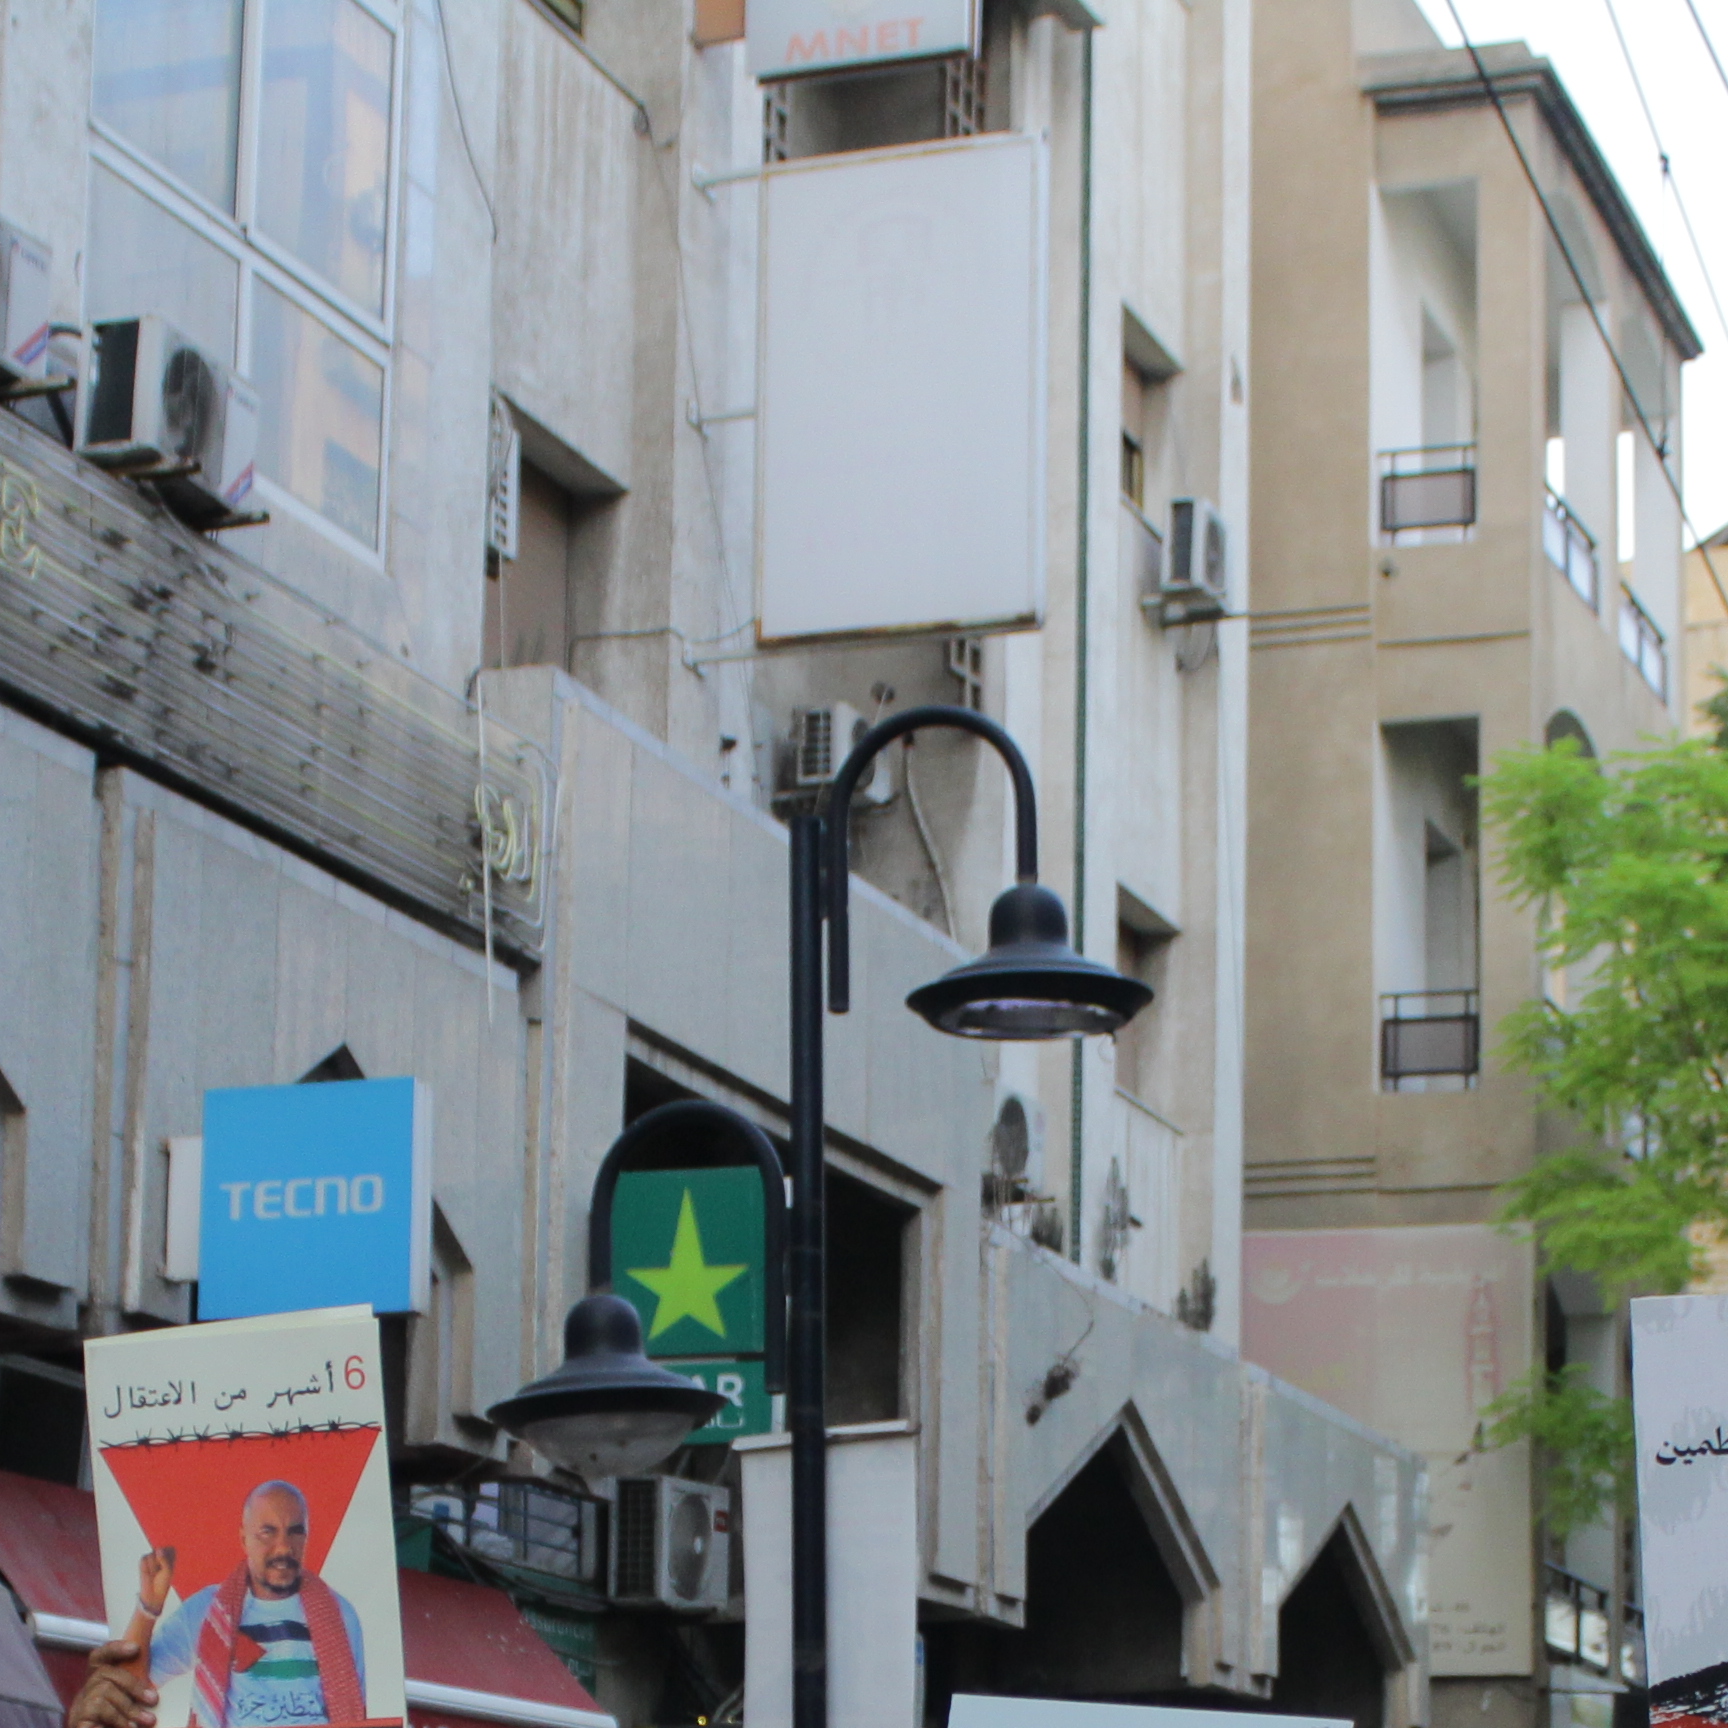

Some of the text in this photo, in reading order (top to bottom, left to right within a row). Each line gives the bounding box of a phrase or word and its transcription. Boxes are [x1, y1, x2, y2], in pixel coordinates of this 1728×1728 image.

[221, 1174, 383, 1221] TECNO
[104, 1355, 367, 1419] 6 أشهر من الاعتقال
